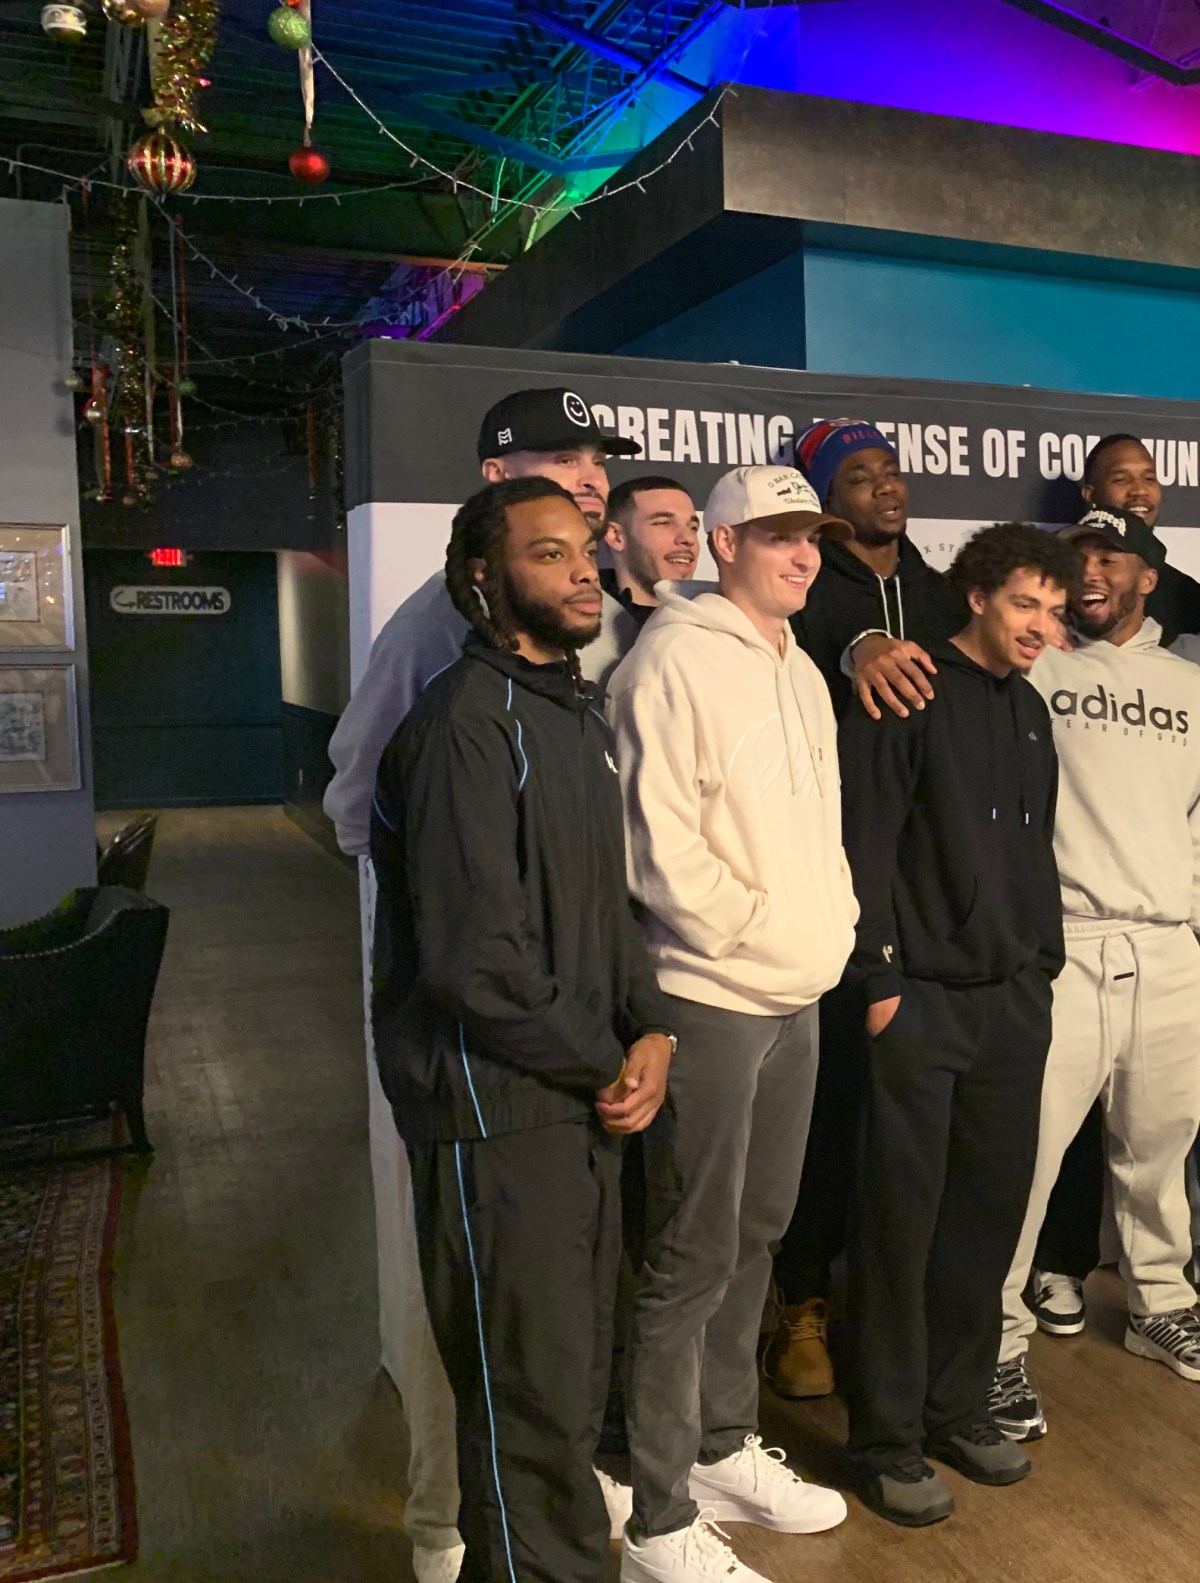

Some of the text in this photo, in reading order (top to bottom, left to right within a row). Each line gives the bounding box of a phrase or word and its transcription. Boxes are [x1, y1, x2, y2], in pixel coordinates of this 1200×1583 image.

[874, 421, 970, 476] NSE
[982, 428, 1026, 478] OF
[137, 590, 225, 610] RESTROOMS
[1050, 684, 1188, 734] adidas
[1123, 727, 1144, 738] OF
[1157, 733, 1187, 747] GOD
